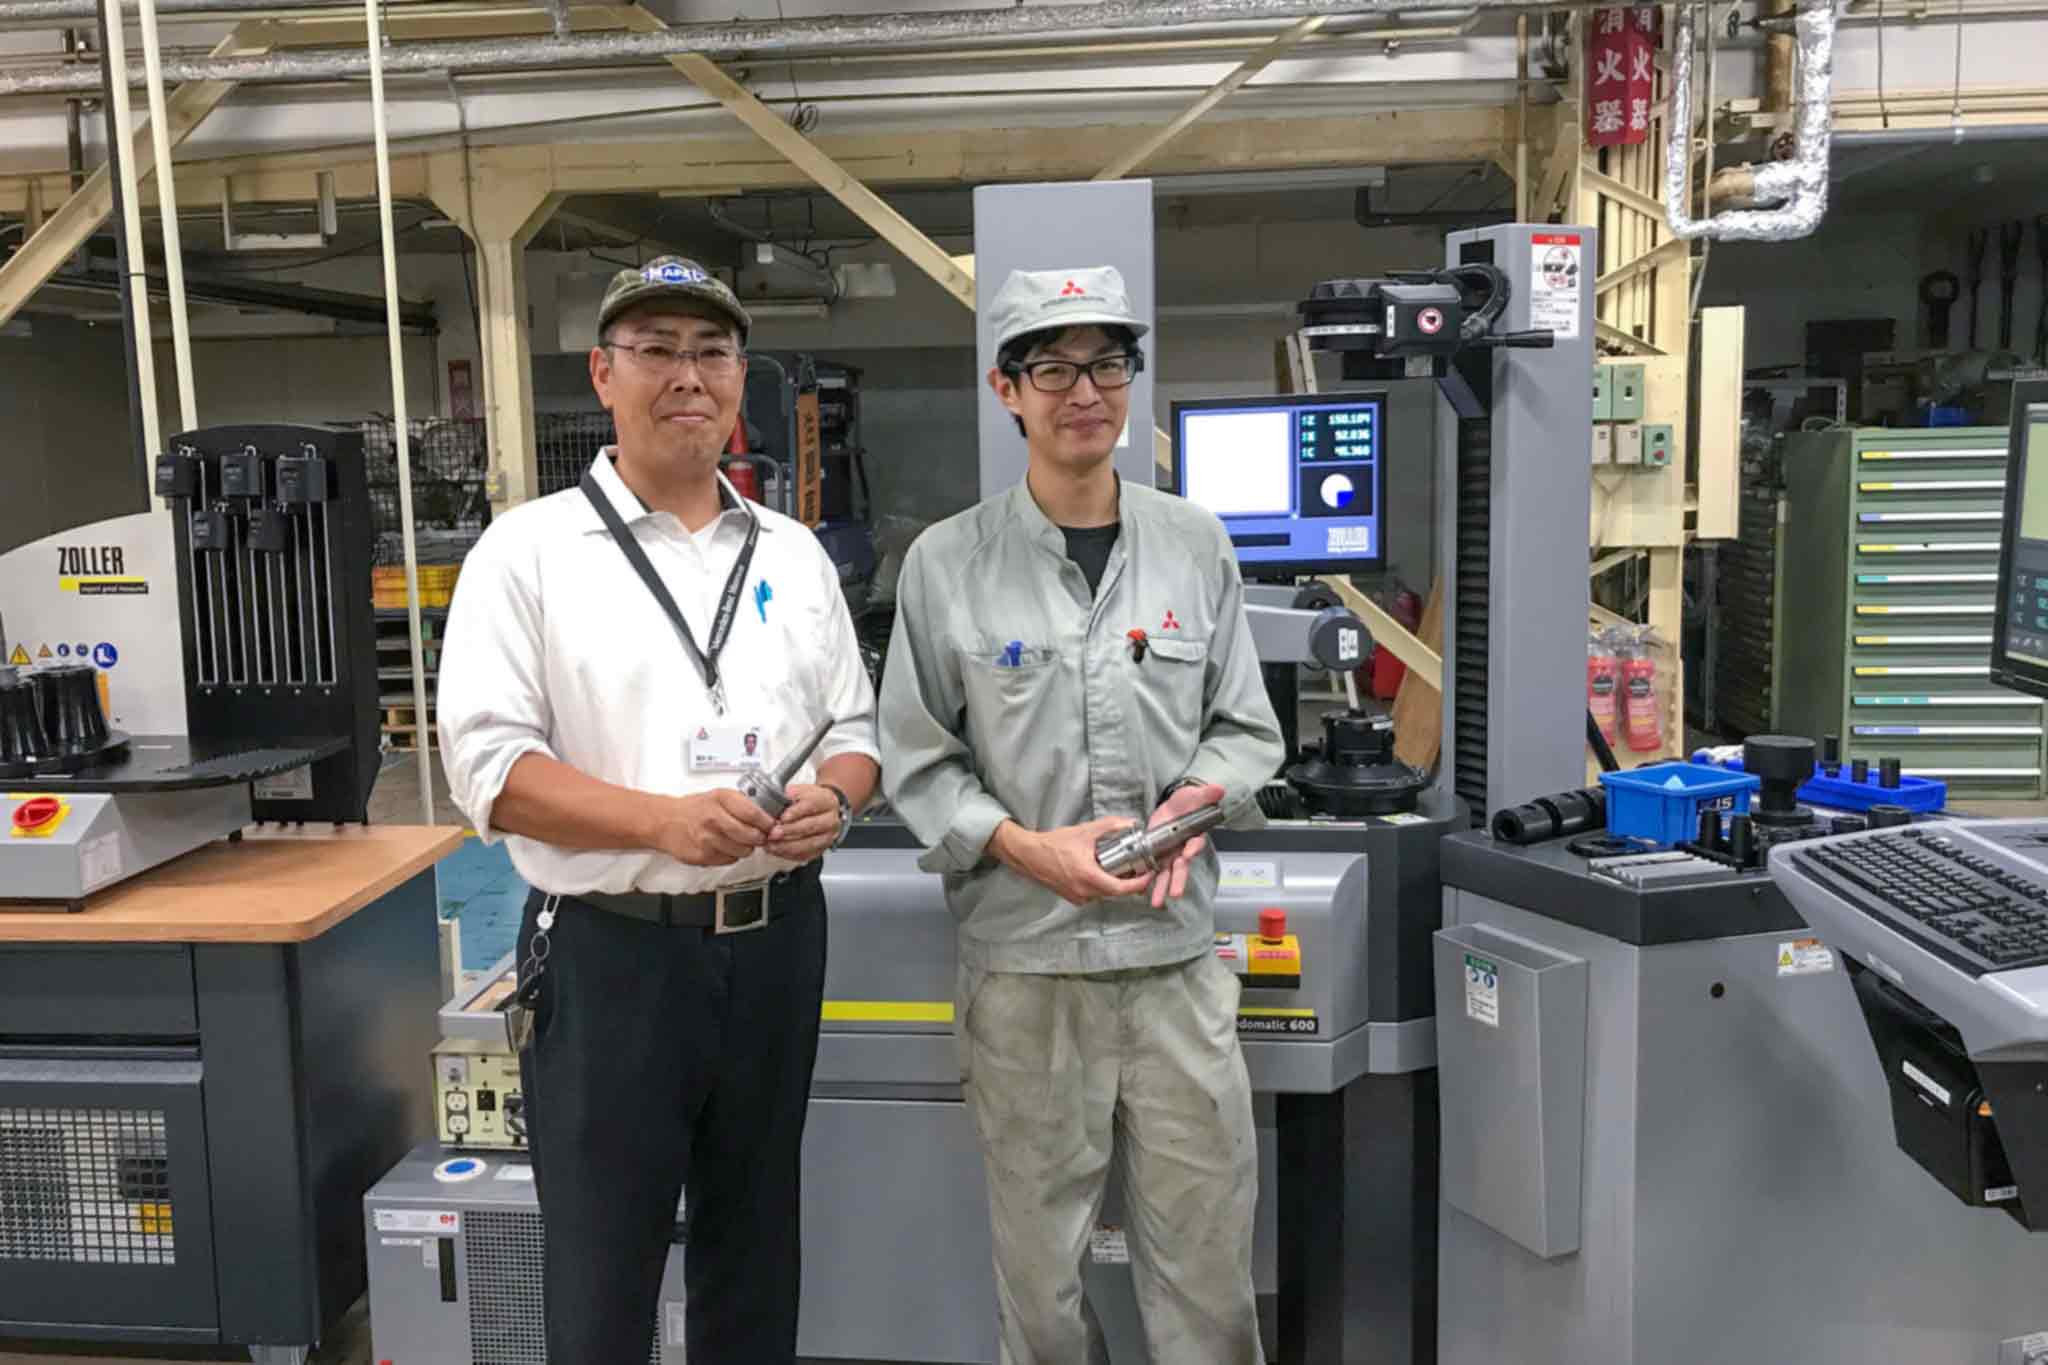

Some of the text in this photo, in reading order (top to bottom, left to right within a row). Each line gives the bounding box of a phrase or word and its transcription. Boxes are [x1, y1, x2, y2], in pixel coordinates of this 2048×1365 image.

[57, 546, 124, 575] ZOLLER
[1238, 1018, 1315, 1031] domatic 600
